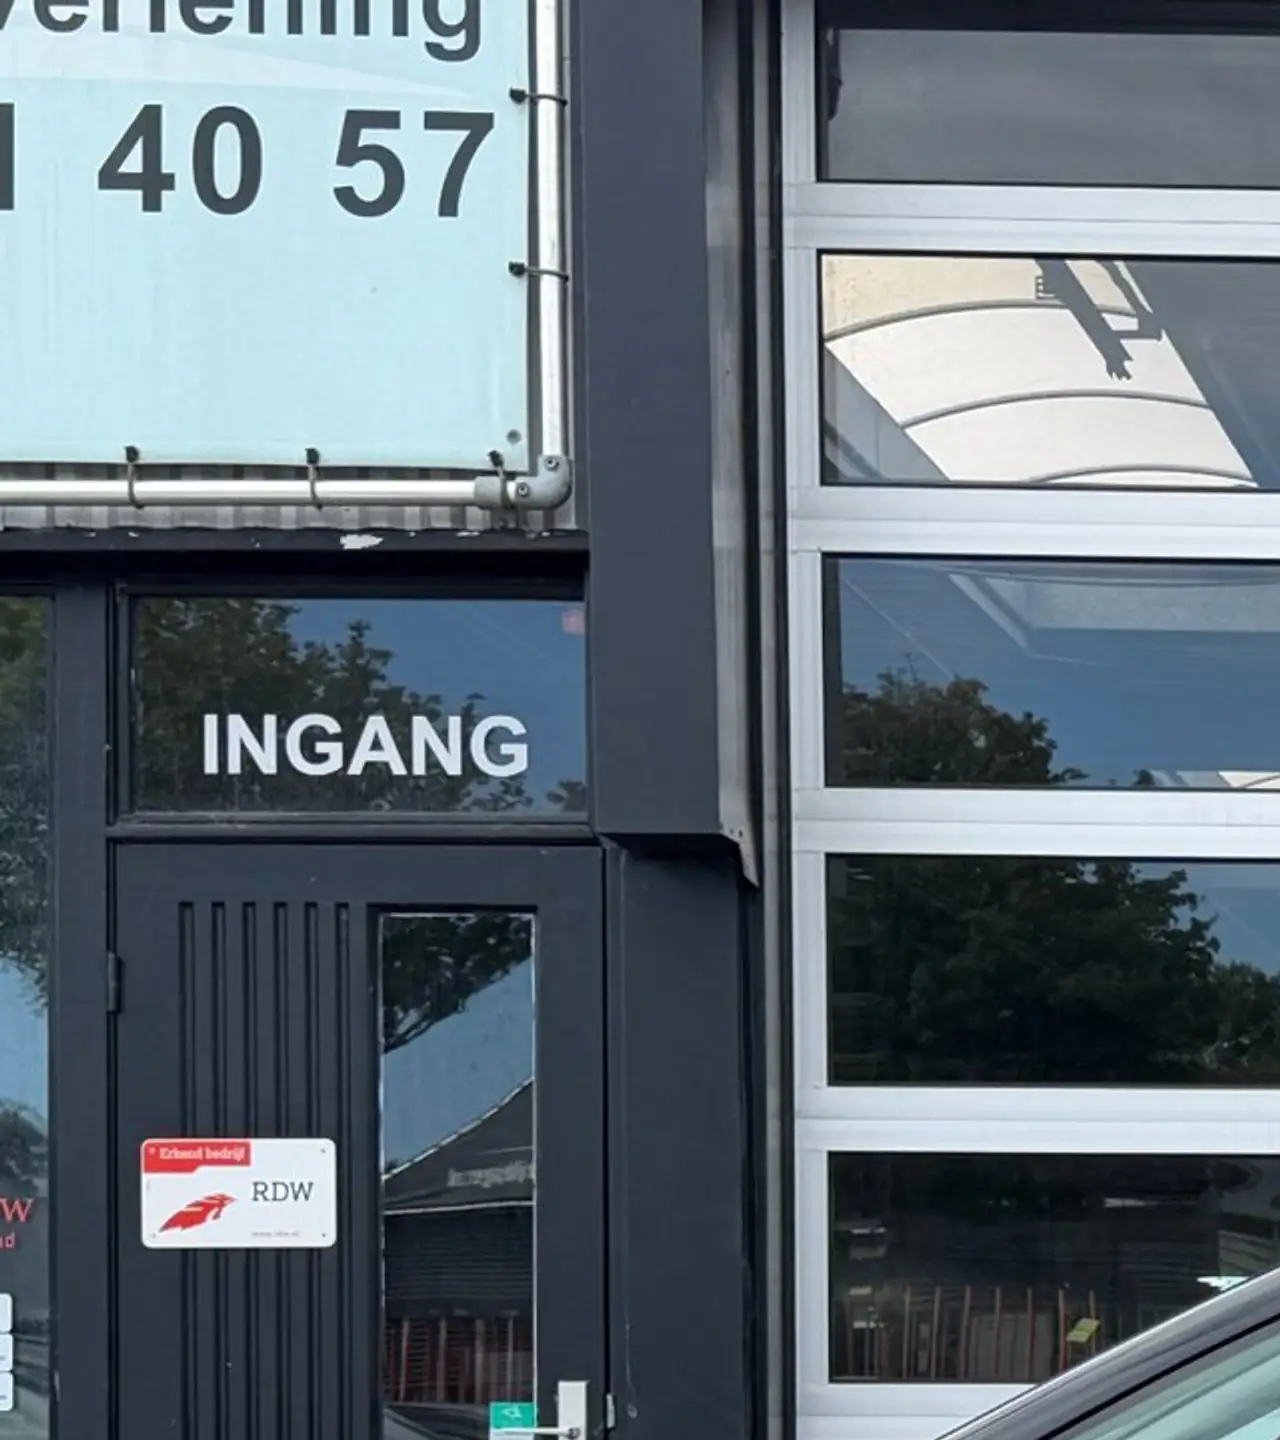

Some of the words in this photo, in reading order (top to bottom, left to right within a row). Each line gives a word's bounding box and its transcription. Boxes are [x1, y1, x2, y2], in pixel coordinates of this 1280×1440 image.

[98, 104, 262, 215] 40
[333, 109, 495, 218] 57
[204, 713, 529, 777] INGANG
[253, 1181, 314, 1202] RDW
